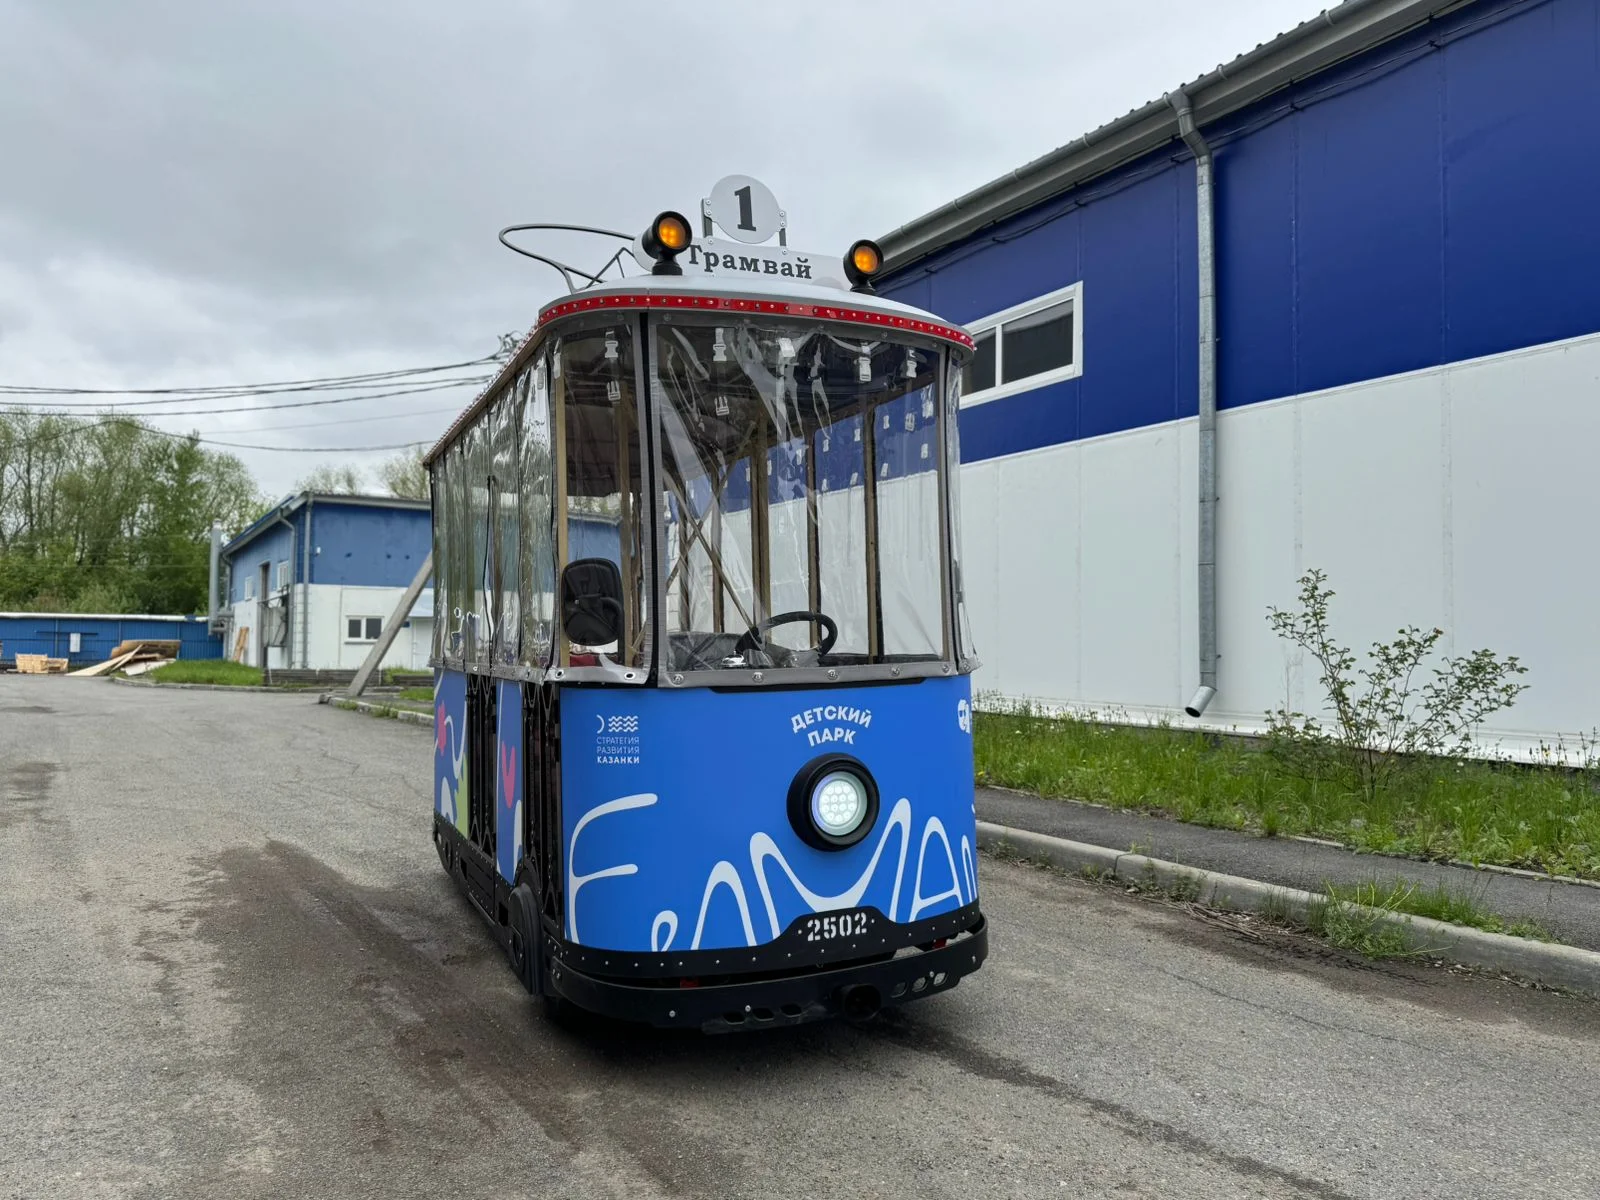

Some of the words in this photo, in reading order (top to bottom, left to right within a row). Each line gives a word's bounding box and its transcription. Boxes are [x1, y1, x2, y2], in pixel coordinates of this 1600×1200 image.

[734, 185, 757, 232] 1
[689, 244, 812, 279] Трамвай
[791, 705, 872, 734] ДЕТСКИЙ
[597, 736, 640, 745] СТРАТЕГИЯ
[808, 727, 856, 747] ПАРК
[597, 746, 640, 754] РАЗВИТИЯ
[597, 756, 640, 764] КАЗАНКИ
[807, 912, 867, 942] 2502
